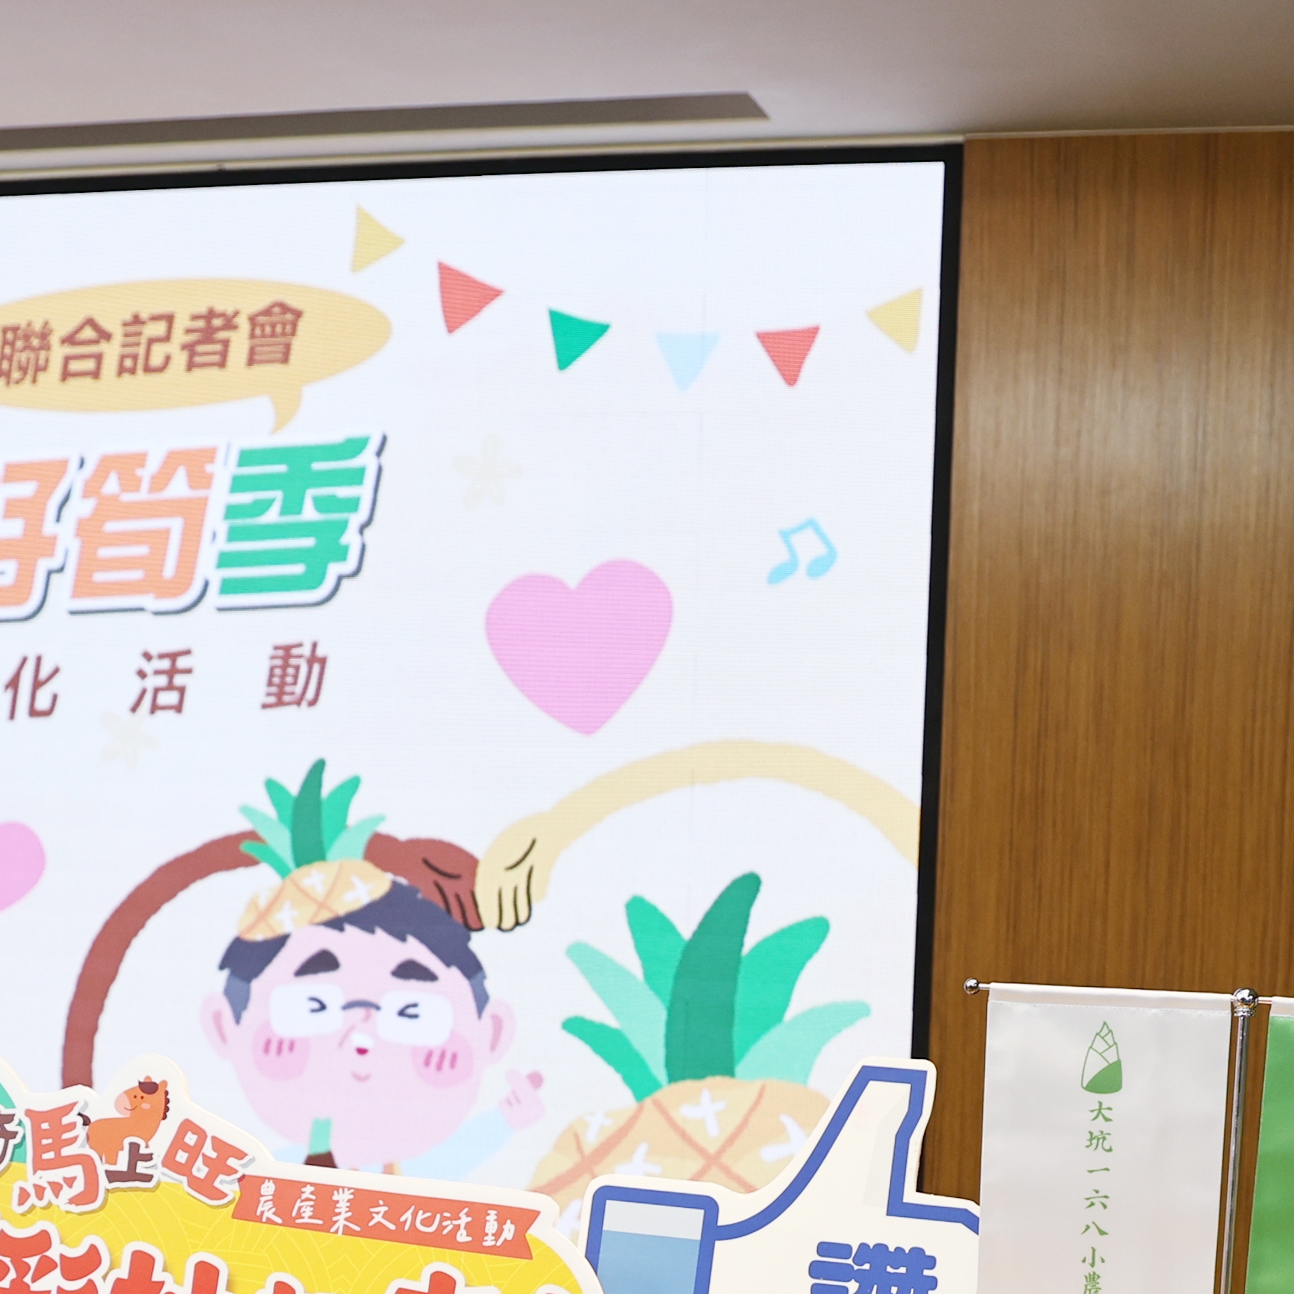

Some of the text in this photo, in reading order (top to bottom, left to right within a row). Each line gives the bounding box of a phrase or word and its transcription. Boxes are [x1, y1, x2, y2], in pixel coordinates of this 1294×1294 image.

[257, 1179, 516, 1247] 農產業文化活動
